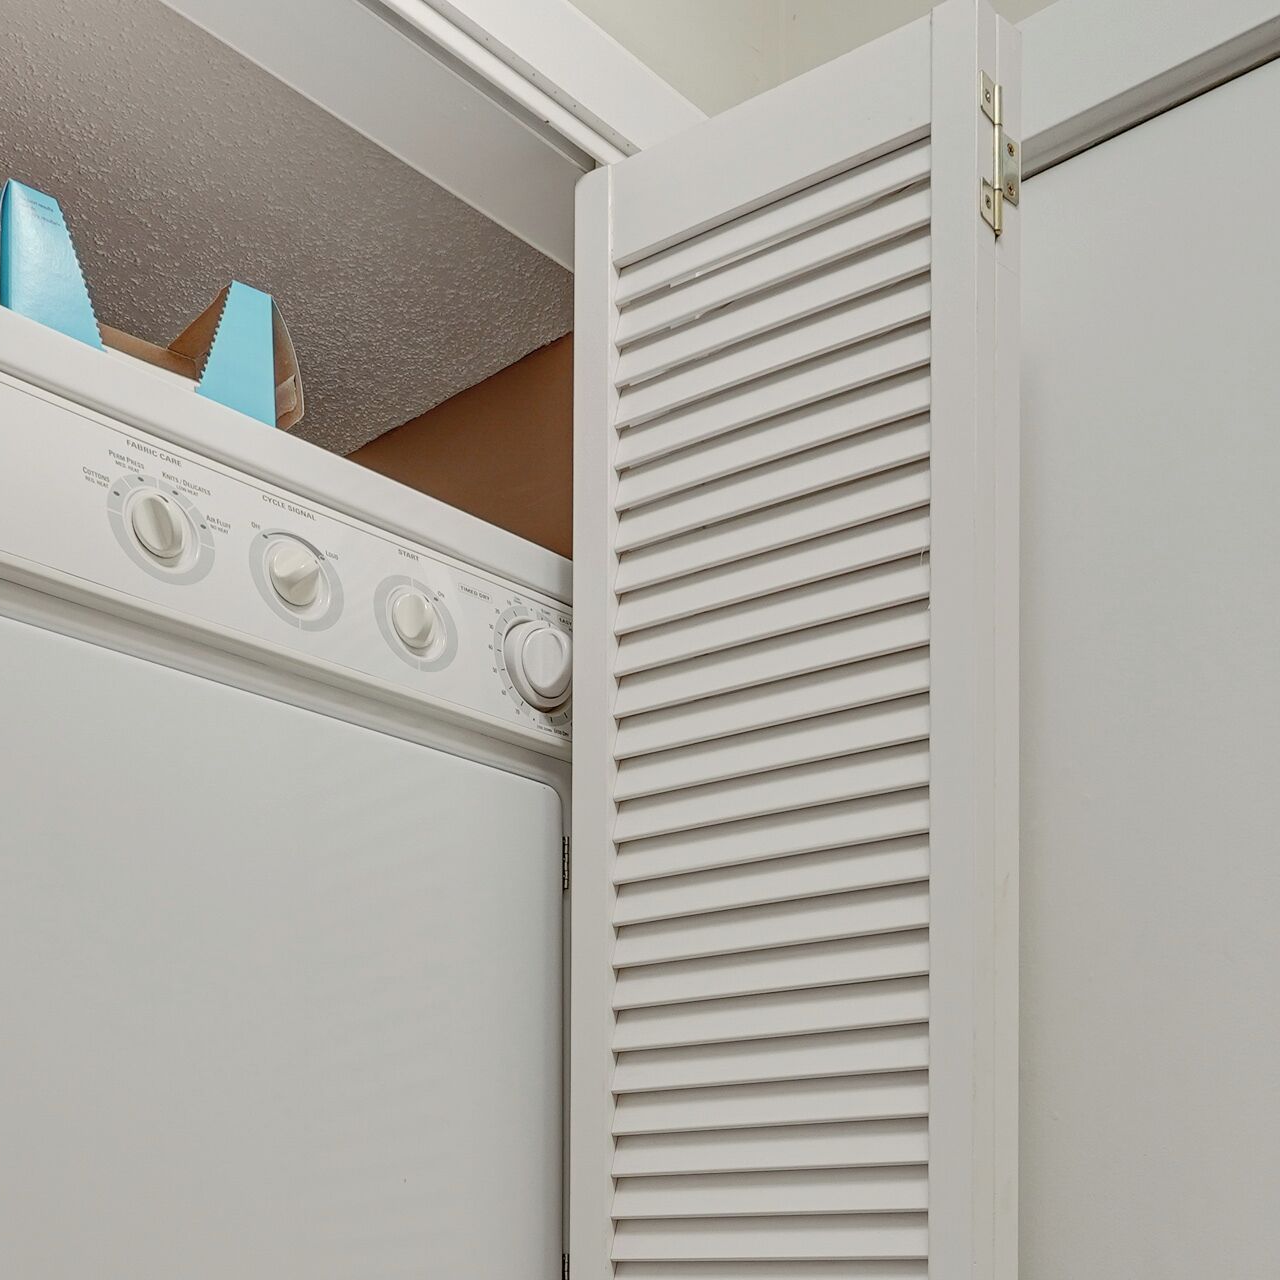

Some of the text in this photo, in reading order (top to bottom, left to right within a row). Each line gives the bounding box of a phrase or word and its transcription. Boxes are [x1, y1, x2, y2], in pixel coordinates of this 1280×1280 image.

[126, 439, 183, 467] FABRIC CARE
[262, 494, 317, 521] CYCLE SIGNAL
[398, 549, 420, 561] START
